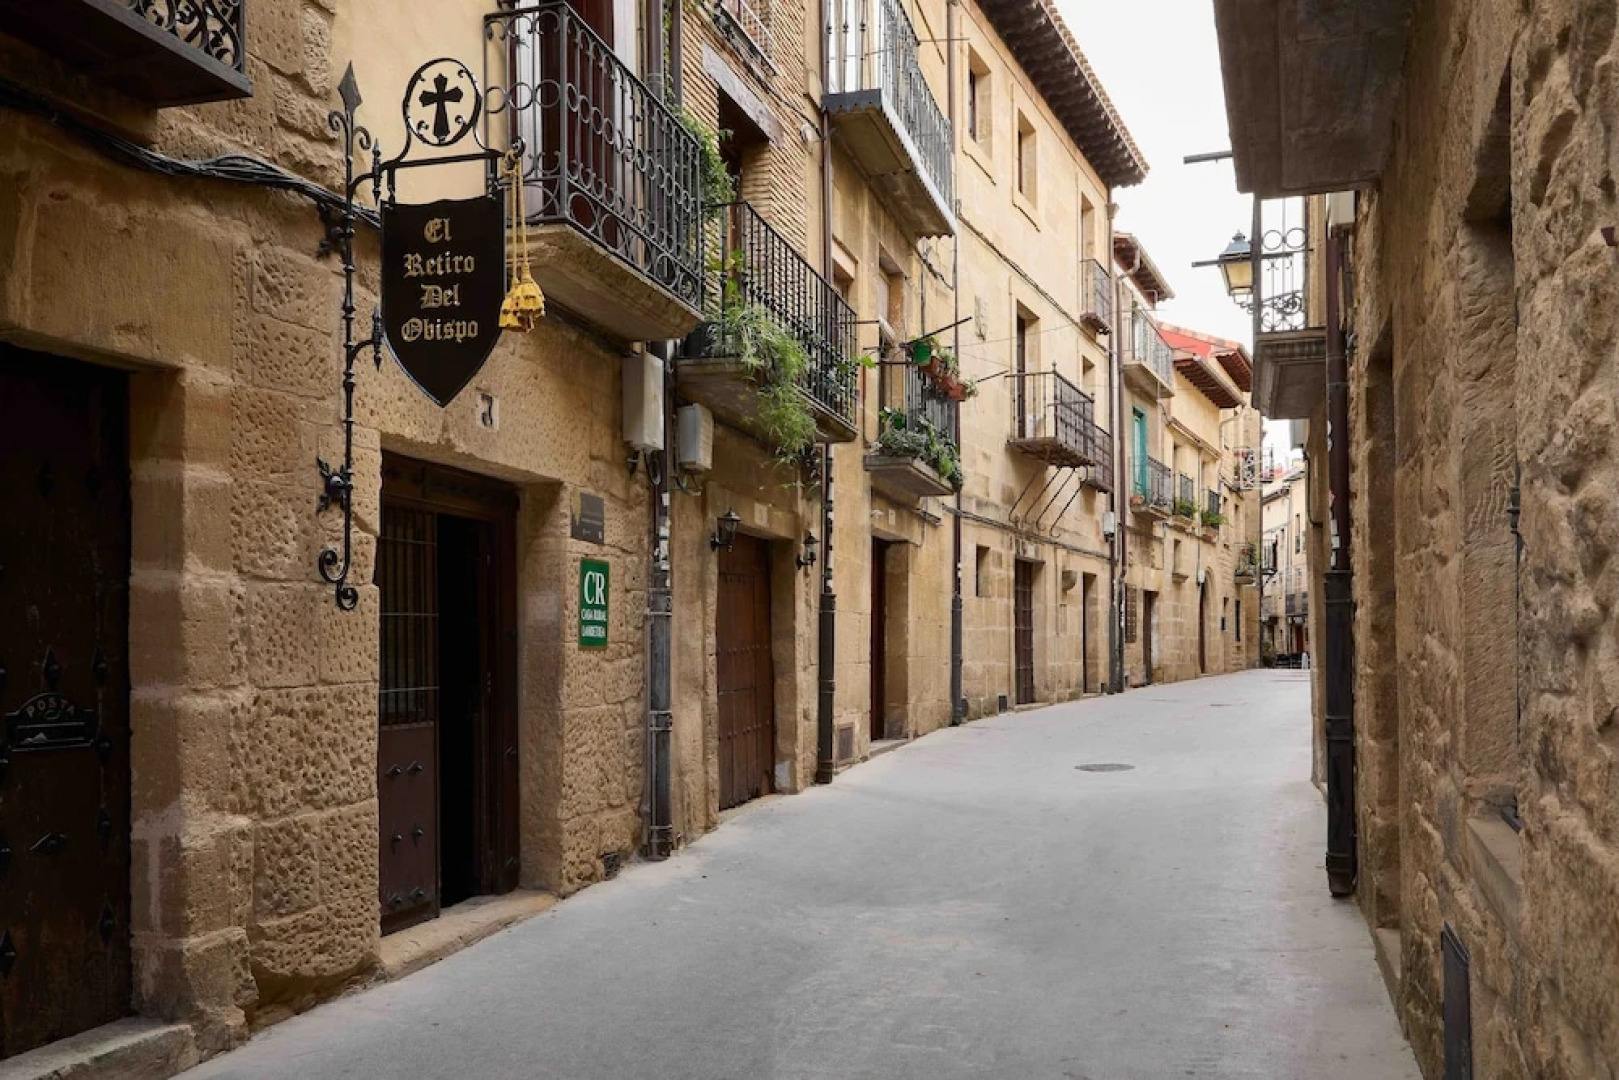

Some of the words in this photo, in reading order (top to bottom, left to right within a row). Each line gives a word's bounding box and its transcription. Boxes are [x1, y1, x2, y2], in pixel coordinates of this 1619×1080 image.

[423, 217, 451, 243] El
[403, 251, 476, 278] Retiro
[420, 284, 460, 309] Del
[401, 318, 479, 343] Obispo
[583, 570, 606, 605] CR
[26, 697, 76, 718] POSTA
